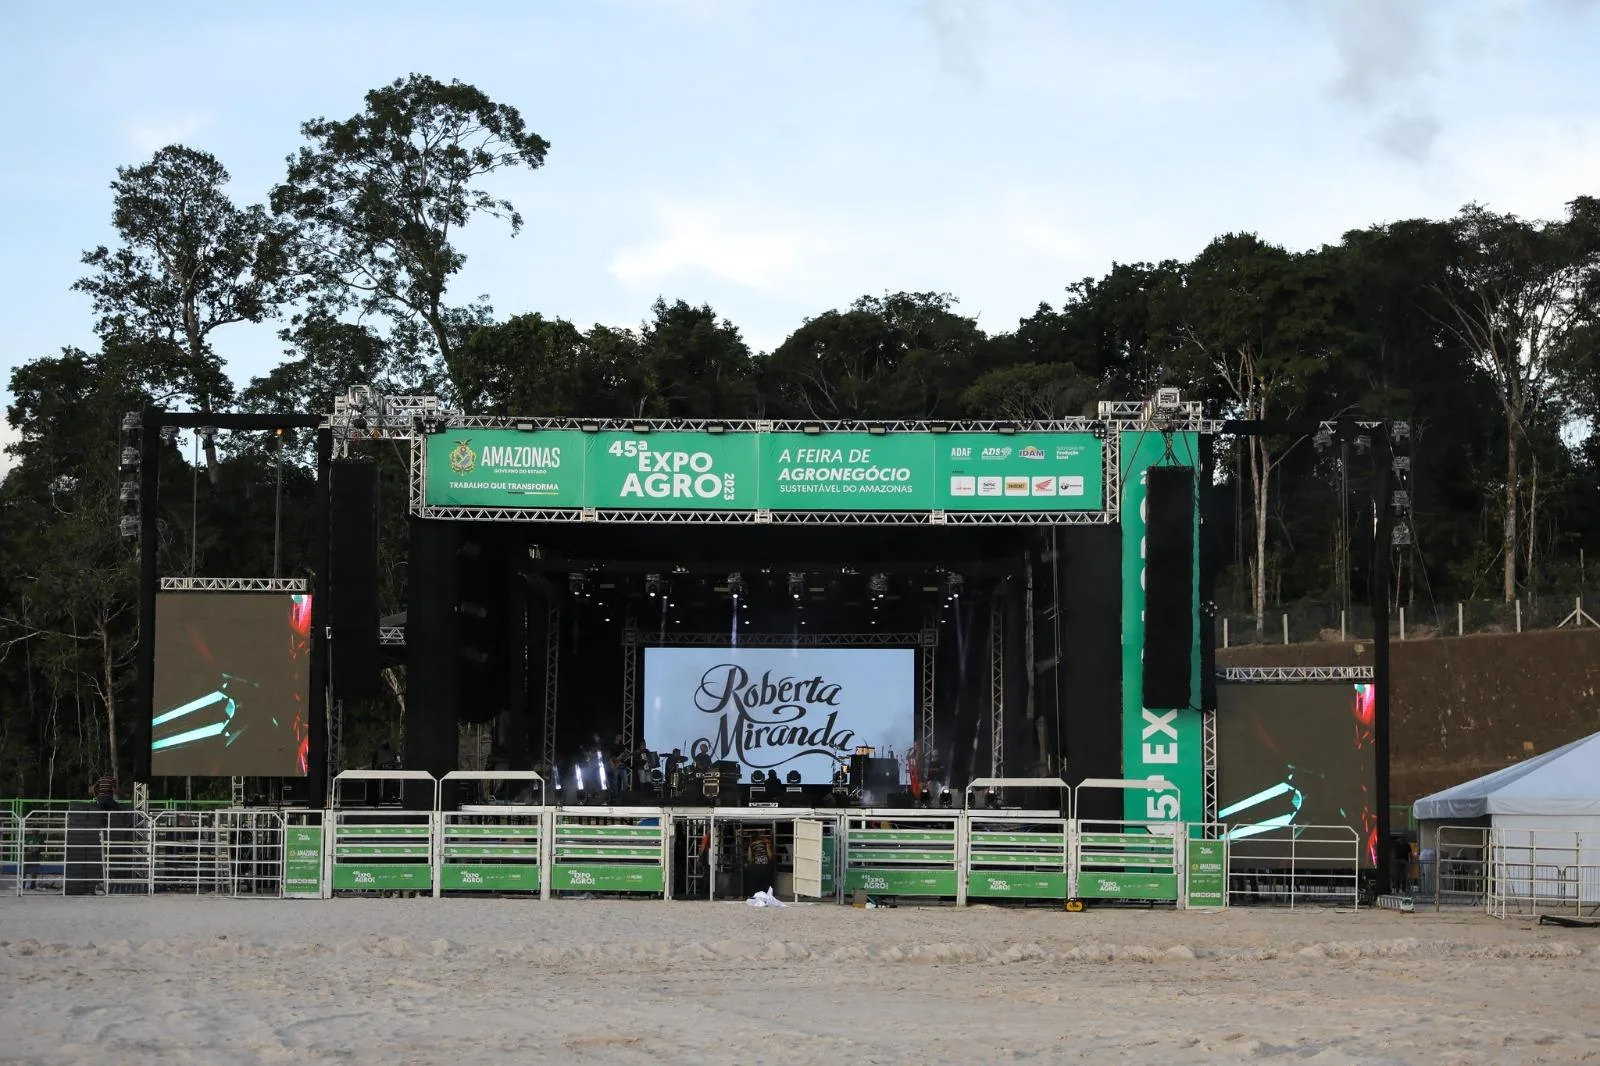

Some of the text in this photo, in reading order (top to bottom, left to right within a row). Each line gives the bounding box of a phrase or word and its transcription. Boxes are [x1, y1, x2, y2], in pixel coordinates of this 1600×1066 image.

[481, 446, 561, 468] AMAZONAS
[638, 452, 713, 472] EXPO
[779, 449, 871, 463] A FEIRA DE
[778, 465, 911, 481] AGRONEGÓCIO
[450, 481, 559, 491] TRABALHO QUE TRANSFORMA
[619, 472, 723, 498] AGRO
[723, 473, 735, 500] 2023
[780, 483, 913, 493] SUSTENTÁVEL DO AMAZONAS
[694, 664, 842, 724] Roberta
[691, 711, 855, 768] Miranda
